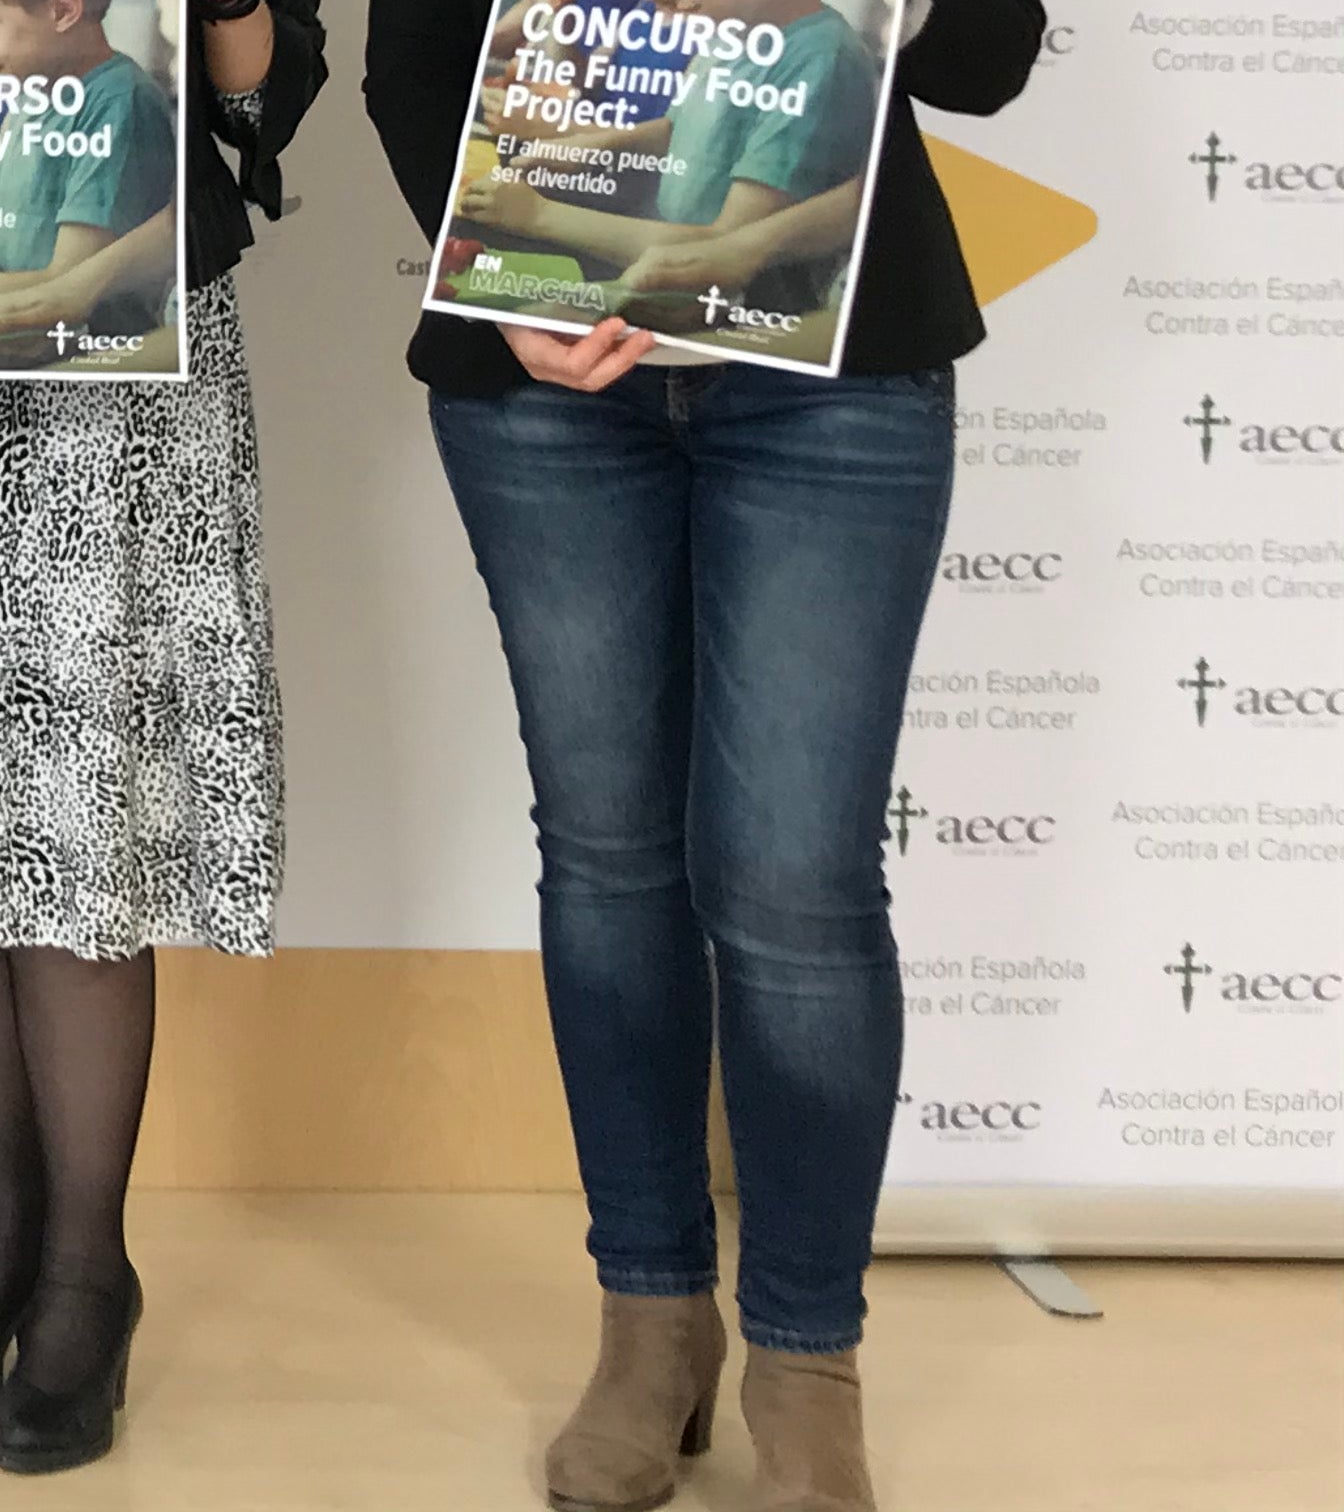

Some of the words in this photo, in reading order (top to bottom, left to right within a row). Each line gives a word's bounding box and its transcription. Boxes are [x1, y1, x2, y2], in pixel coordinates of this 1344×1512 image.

[522, 2, 784, 66] CONCURSO
[1130, 12, 1264, 37] Asociación
[1152, 48, 1234, 72] Contra
[515, 49, 576, 85] The
[584, 54, 697, 106] Funny
[706, 69, 807, 117] Food
[503, 83, 636, 132] Project:
[22, 123, 111, 158] Food
[496, 133, 514, 155] El
[519, 137, 613, 167] almuerzo
[618, 150, 688, 177] puede
[490, 164, 520, 185] ser
[525, 164, 617, 196] divertido
[1245, 160, 1344, 191] aec
[475, 254, 503, 273] EN
[469, 267, 606, 311] MARCHA
[1124, 276, 1259, 301] Asociación
[728, 306, 802, 333] aecc
[1146, 311, 1229, 336] Contra
[78, 333, 144, 351] aecc
[994, 407, 1106, 435] Española
[962, 444, 983, 467] el
[994, 445, 1081, 468] Cáncer
[1117, 538, 1253, 563] Asociación
[942, 551, 1062, 583] aecc
[1140, 574, 1223, 598] Contra
[987, 671, 1100, 697] Española
[956, 707, 978, 730] el
[989, 707, 1076, 731] Cáncer
[1112, 800, 1248, 826] Asociación
[936, 815, 1056, 846] aecc
[1135, 837, 1217, 861] Contra
[971, 957, 1085, 983] Española
[1221, 972, 1342, 1002] aecc
[941, 993, 962, 1015] el
[971, 993, 1061, 1017] Cáncer
[1098, 1087, 1235, 1113] Asociación
[921, 1099, 1041, 1131] aecc
[1121, 1123, 1204, 1147] Contra
[1244, 1125, 1334, 1150] Cáncer
